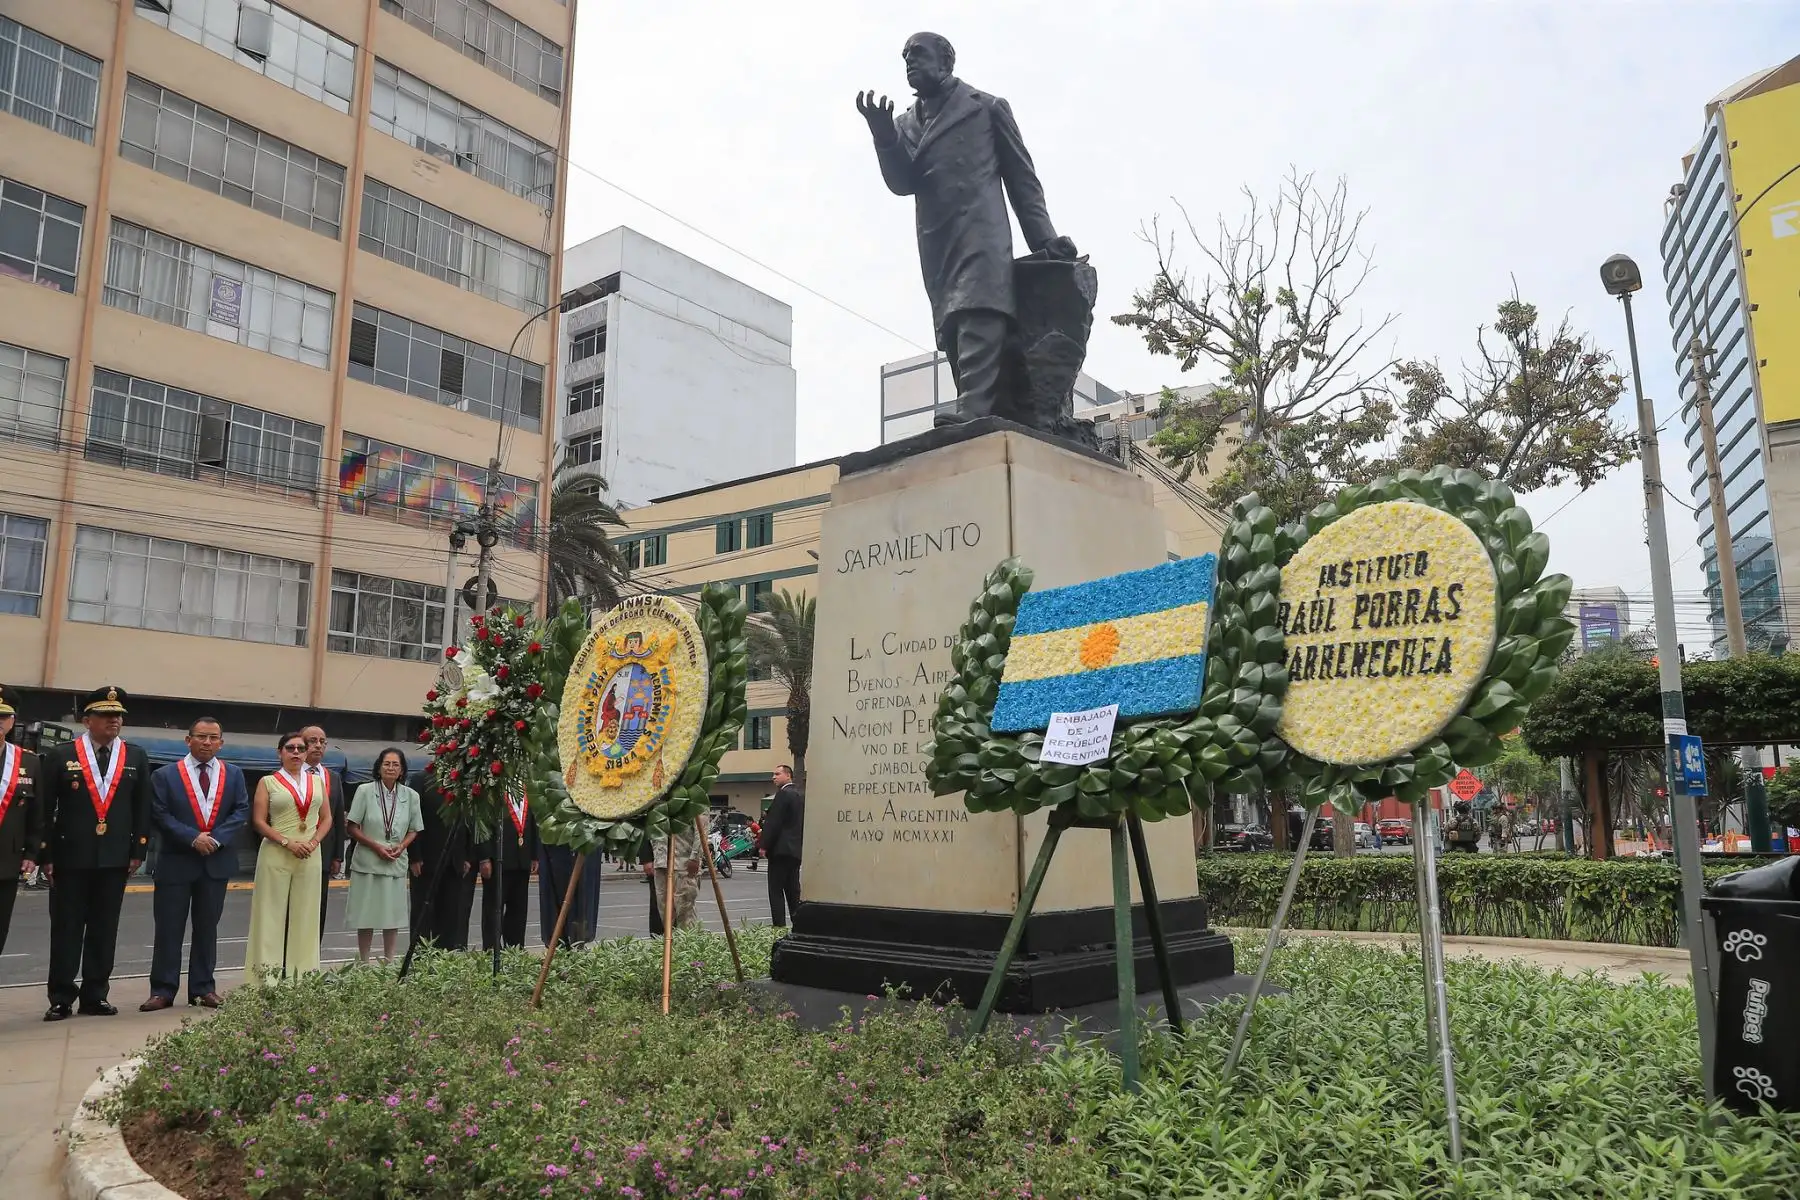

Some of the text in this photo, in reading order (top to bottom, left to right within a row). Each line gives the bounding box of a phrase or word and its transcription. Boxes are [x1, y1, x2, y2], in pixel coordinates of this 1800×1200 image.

[837, 522, 981, 574] SARMIENTO
[1318, 550, 1429, 589] INSTITUTO
[1351, 582, 1464, 630] PORRAS
[850, 637, 872, 661] LA
[1284, 636, 1453, 682] ARRENECHEA
[912, 661, 951, 686] AIRE
[1055, 709, 1112, 724] EMBAJADA
[1067, 725, 1099, 736] DE LA
[894, 742, 908, 755] DE
[1044, 747, 1106, 761] ARGENTINA
[869, 761, 927, 776] SIMBOLO
[844, 781, 928, 795] REPRESENTAT
[837, 799, 969, 823] DE LA ARGENTINA
[850, 829, 954, 843] MAYO MCMXXXI
